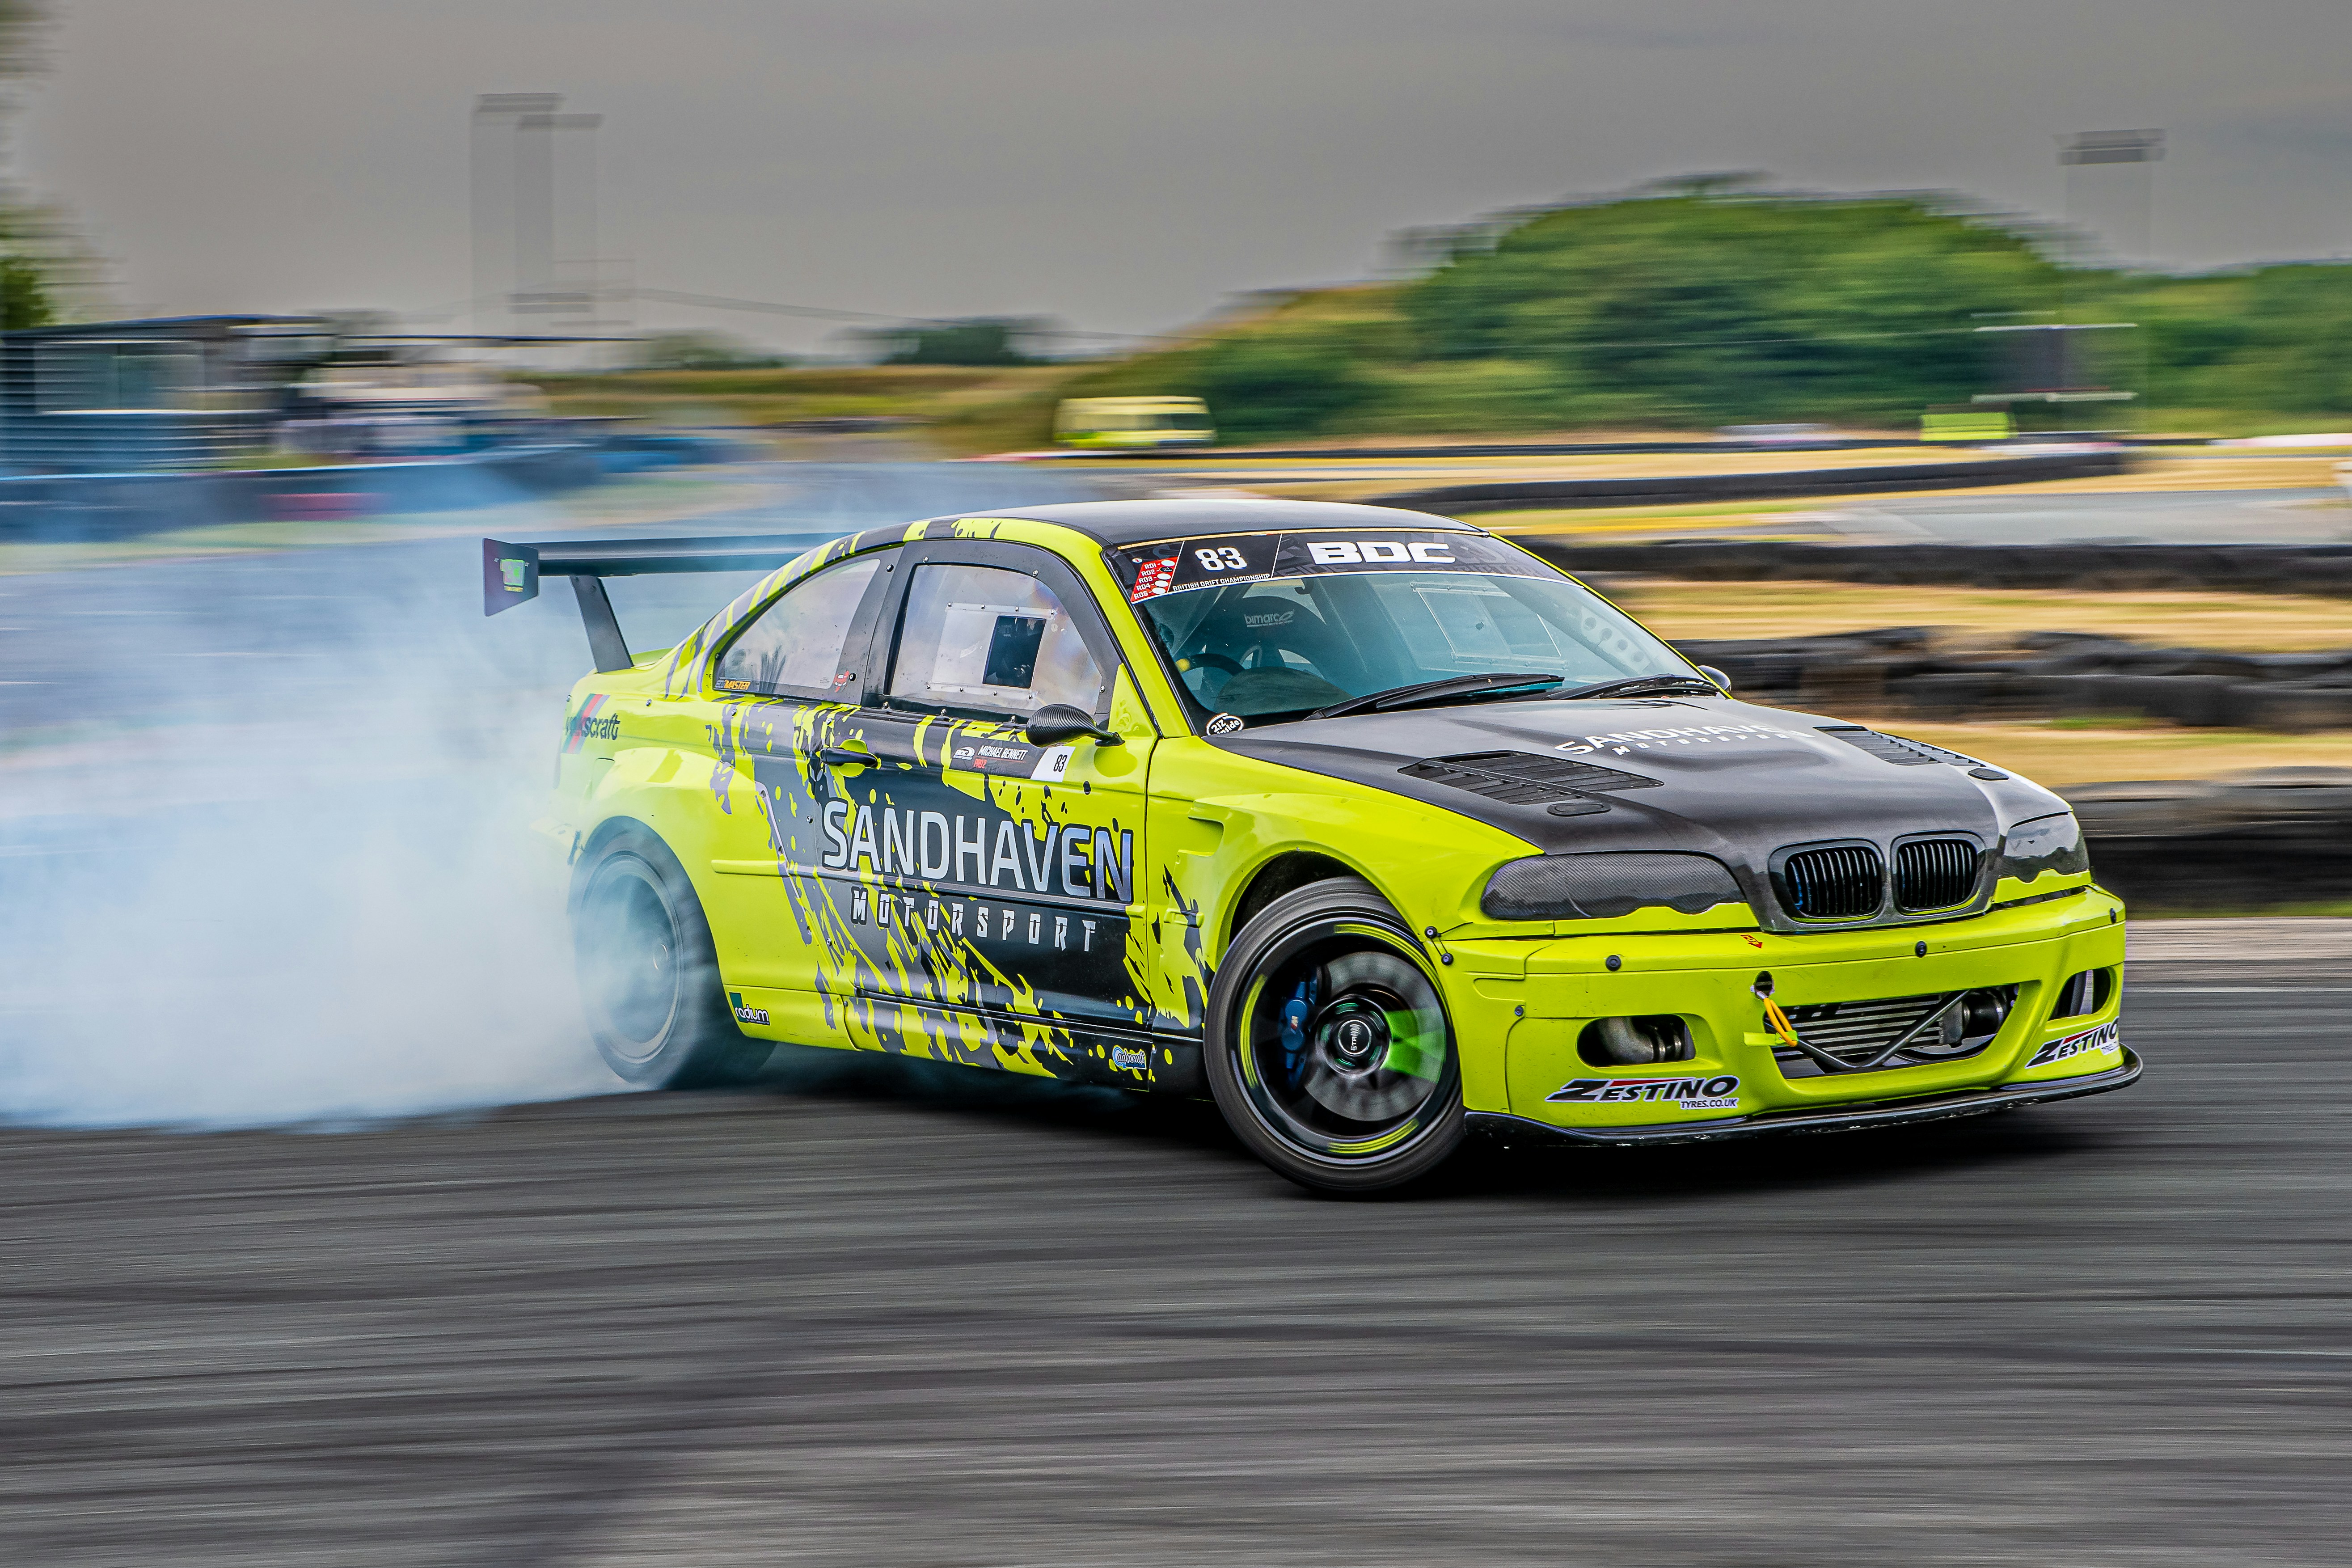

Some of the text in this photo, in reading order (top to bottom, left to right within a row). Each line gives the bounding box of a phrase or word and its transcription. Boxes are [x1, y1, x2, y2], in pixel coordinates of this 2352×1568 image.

[1195, 547, 1247, 571] 83
[1306, 541, 1456, 564] BDC
[1172, 573, 1270, 592] BRITISH DRIFT CHAMPIONSHIP
[1211, 719, 1227, 733] 2JZ
[978, 745, 1002, 758] MICHAEL
[1001, 748, 1028, 761] BENNETT
[1612, 734, 1790, 756] MOTORSPOR
[1053, 754, 1068, 772] 83
[823, 801, 1132, 901] SANDHAVEN
[853, 890, 1096, 952] MOTORSPORT
[735, 1005, 769, 1022] radium
[1545, 1076, 1739, 1101] ZESTINO
[1681, 1099, 1737, 1108] TYRES.CO.UK
